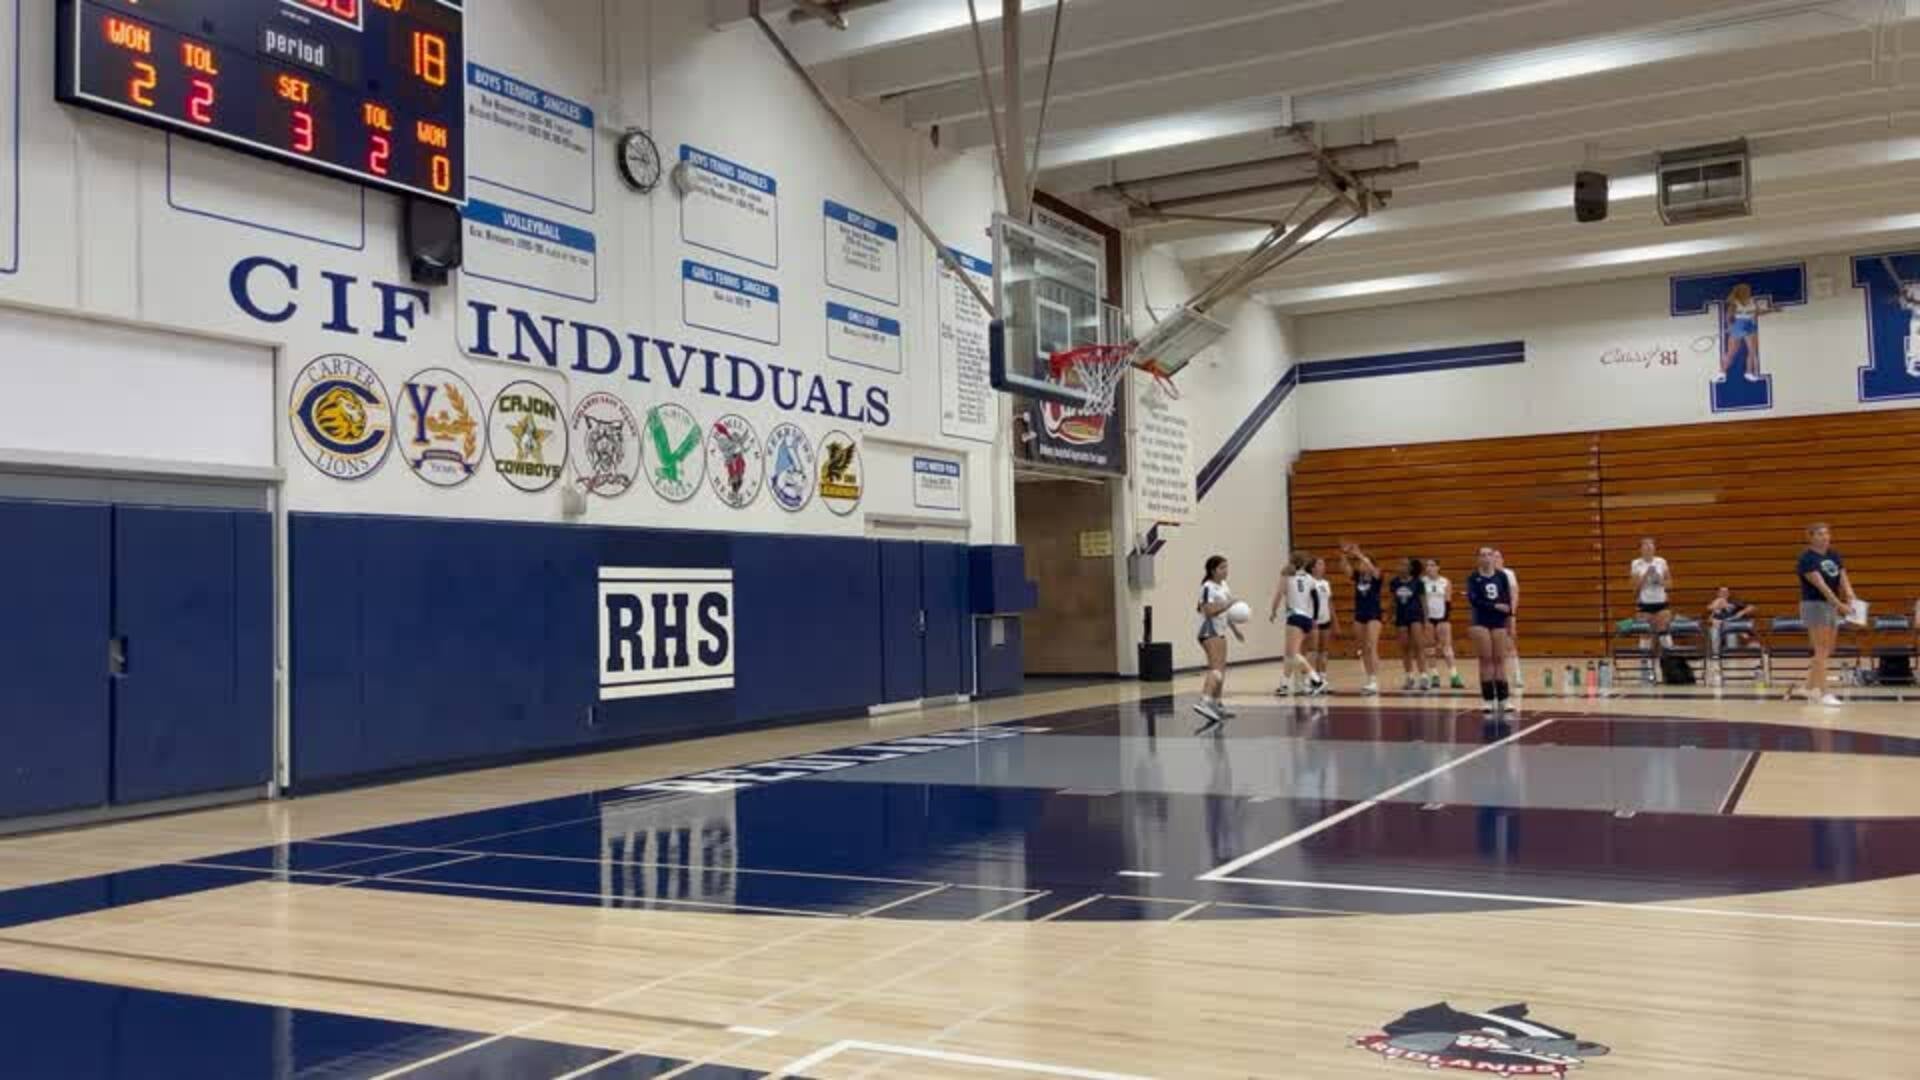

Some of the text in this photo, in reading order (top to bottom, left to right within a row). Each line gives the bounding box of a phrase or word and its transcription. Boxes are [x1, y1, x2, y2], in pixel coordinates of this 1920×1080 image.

[108, 18, 151, 53] WON
[265, 28, 325, 67] period
[182, 42, 218, 75] TOL
[412, 30, 447, 87] 18
[131, 61, 156, 106] 2
[278, 74, 310, 104] SET
[190, 80, 214, 123] 2
[364, 103, 393, 131] TOL
[292, 110, 313, 151] 3
[416, 120, 447, 149] WON
[370, 135, 390, 175] 2
[432, 154, 450, 192] 0
[502, 211, 560, 241] VOLLEYBALL
[229, 256, 432, 343] CIF
[468, 299, 891, 428] INDIVIDUALS
[307, 358, 376, 393] CARTER
[499, 394, 557, 422] CAJON
[317, 449, 370, 476] LIONS
[495, 459, 561, 480] COWBOYS
[1485, 583, 1499, 600] 9
[605, 591, 729, 672] RHS
